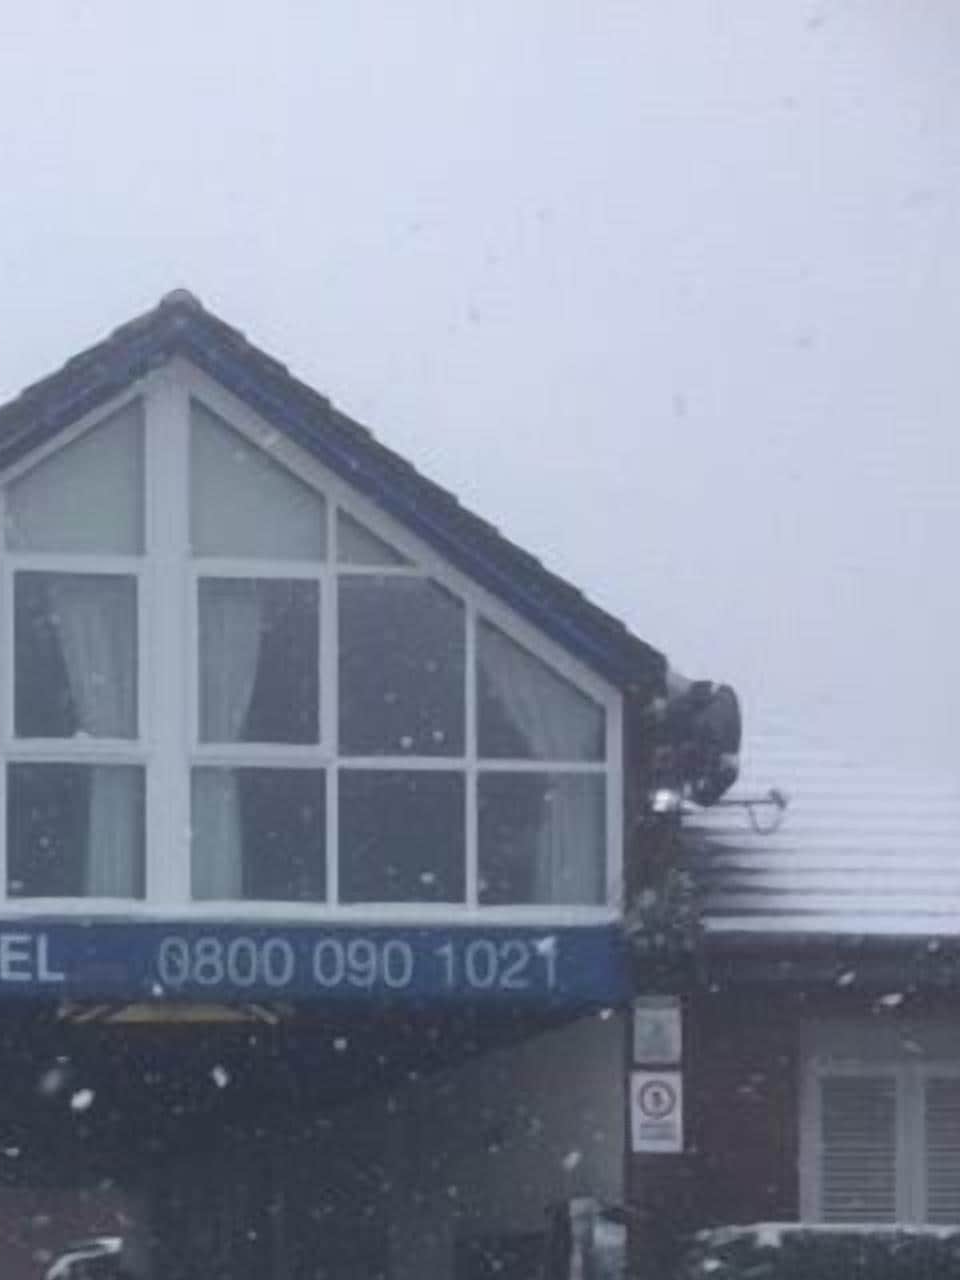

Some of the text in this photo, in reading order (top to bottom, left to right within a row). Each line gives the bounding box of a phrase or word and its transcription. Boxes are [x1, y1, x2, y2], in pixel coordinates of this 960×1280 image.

[157, 936, 295, 987] 0800
[312, 938, 414, 988] 090
[436, 938, 558, 988] 1021
